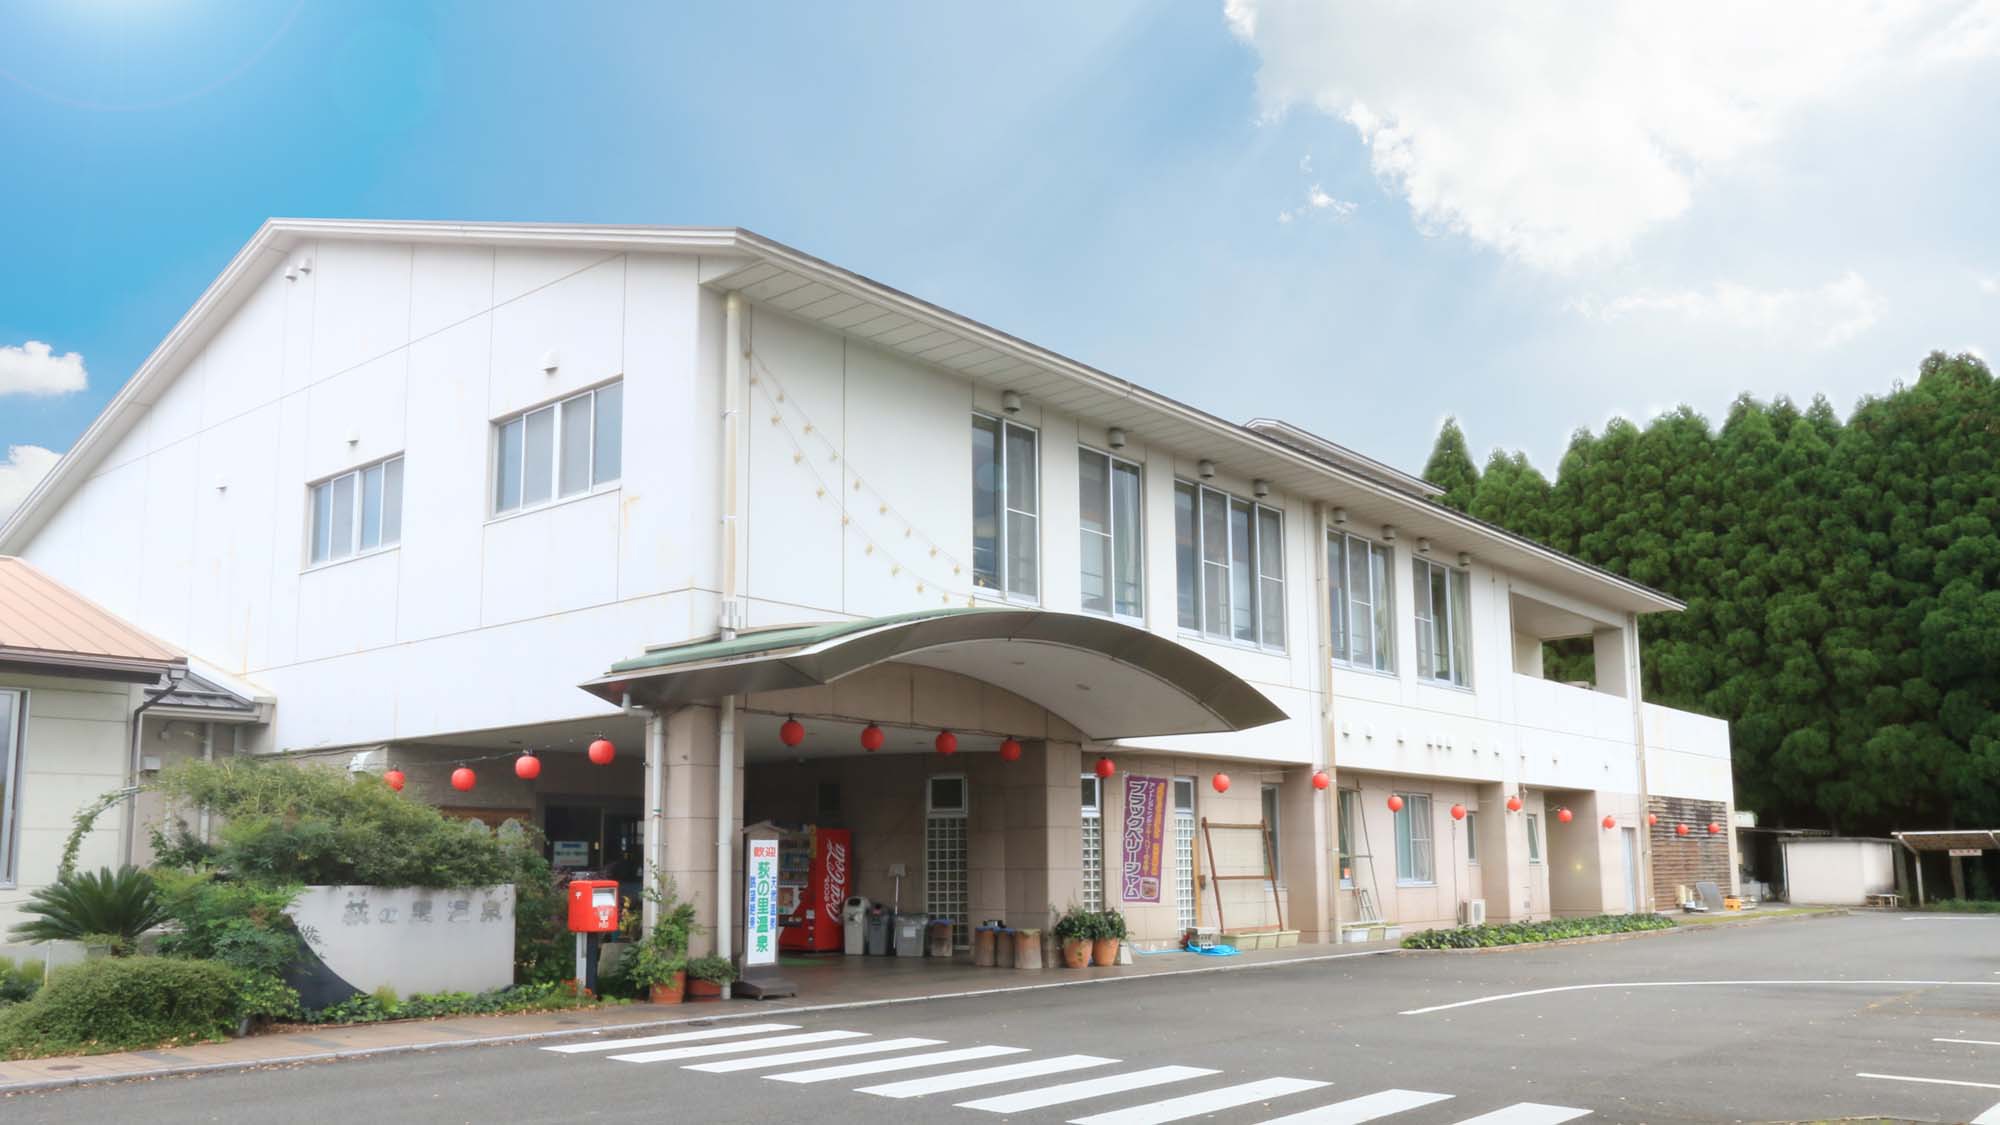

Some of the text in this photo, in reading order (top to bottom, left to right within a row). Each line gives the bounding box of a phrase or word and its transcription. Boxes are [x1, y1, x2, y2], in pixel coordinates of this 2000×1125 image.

[754, 847, 776, 857] 歓迎
[826, 838, 845, 922] Coca-Cola
[1126, 781, 1147, 898] ブラックベリージャム
[756, 861, 770, 952] 荻の里温泉
